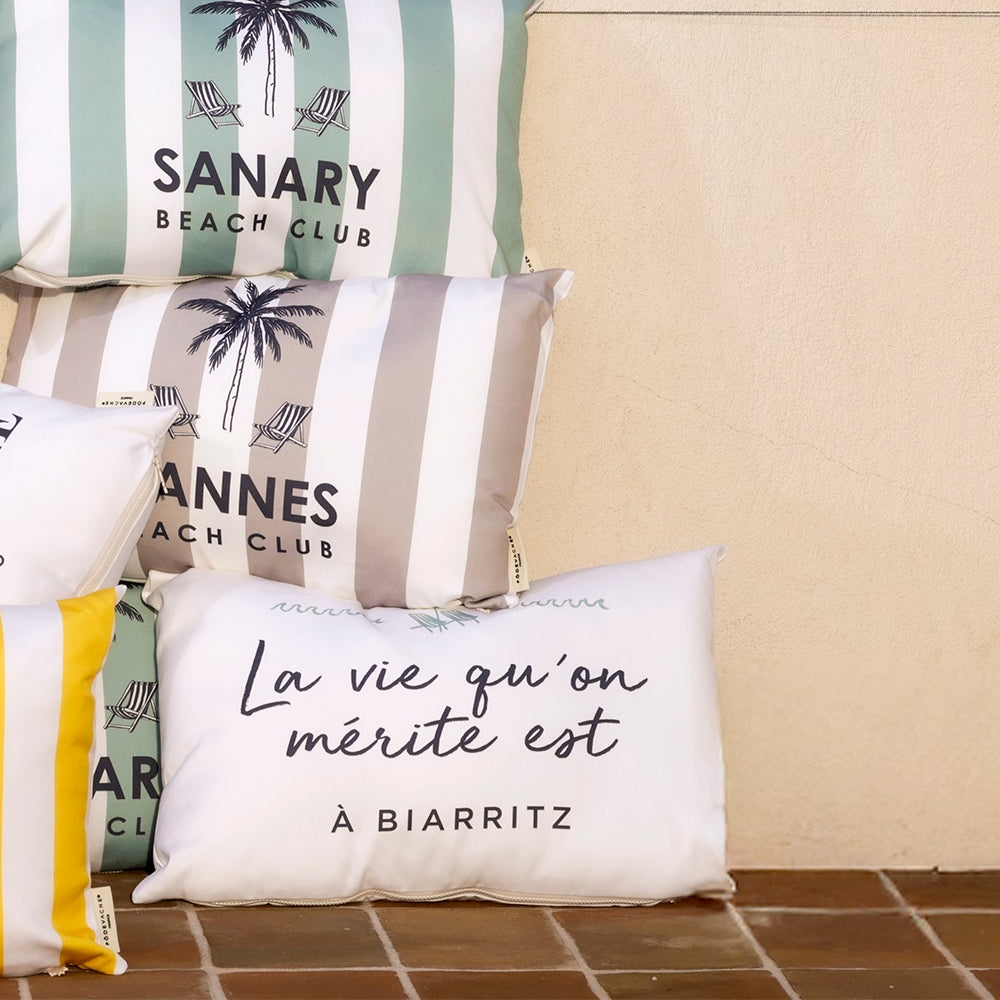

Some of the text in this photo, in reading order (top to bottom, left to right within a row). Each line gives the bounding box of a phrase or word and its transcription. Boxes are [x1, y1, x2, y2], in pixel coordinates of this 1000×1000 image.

[153, 147, 381, 210] SANARY
[156, 209, 371, 248] BEACH CLUB
[155, 461, 339, 528] ANNES
[140, 521, 333, 560] ACH CLUB
[240, 639, 649, 718] La vie qu'on
[286, 705, 621, 759] mérite est
[331, 805, 572, 833] À BIARRITZ
